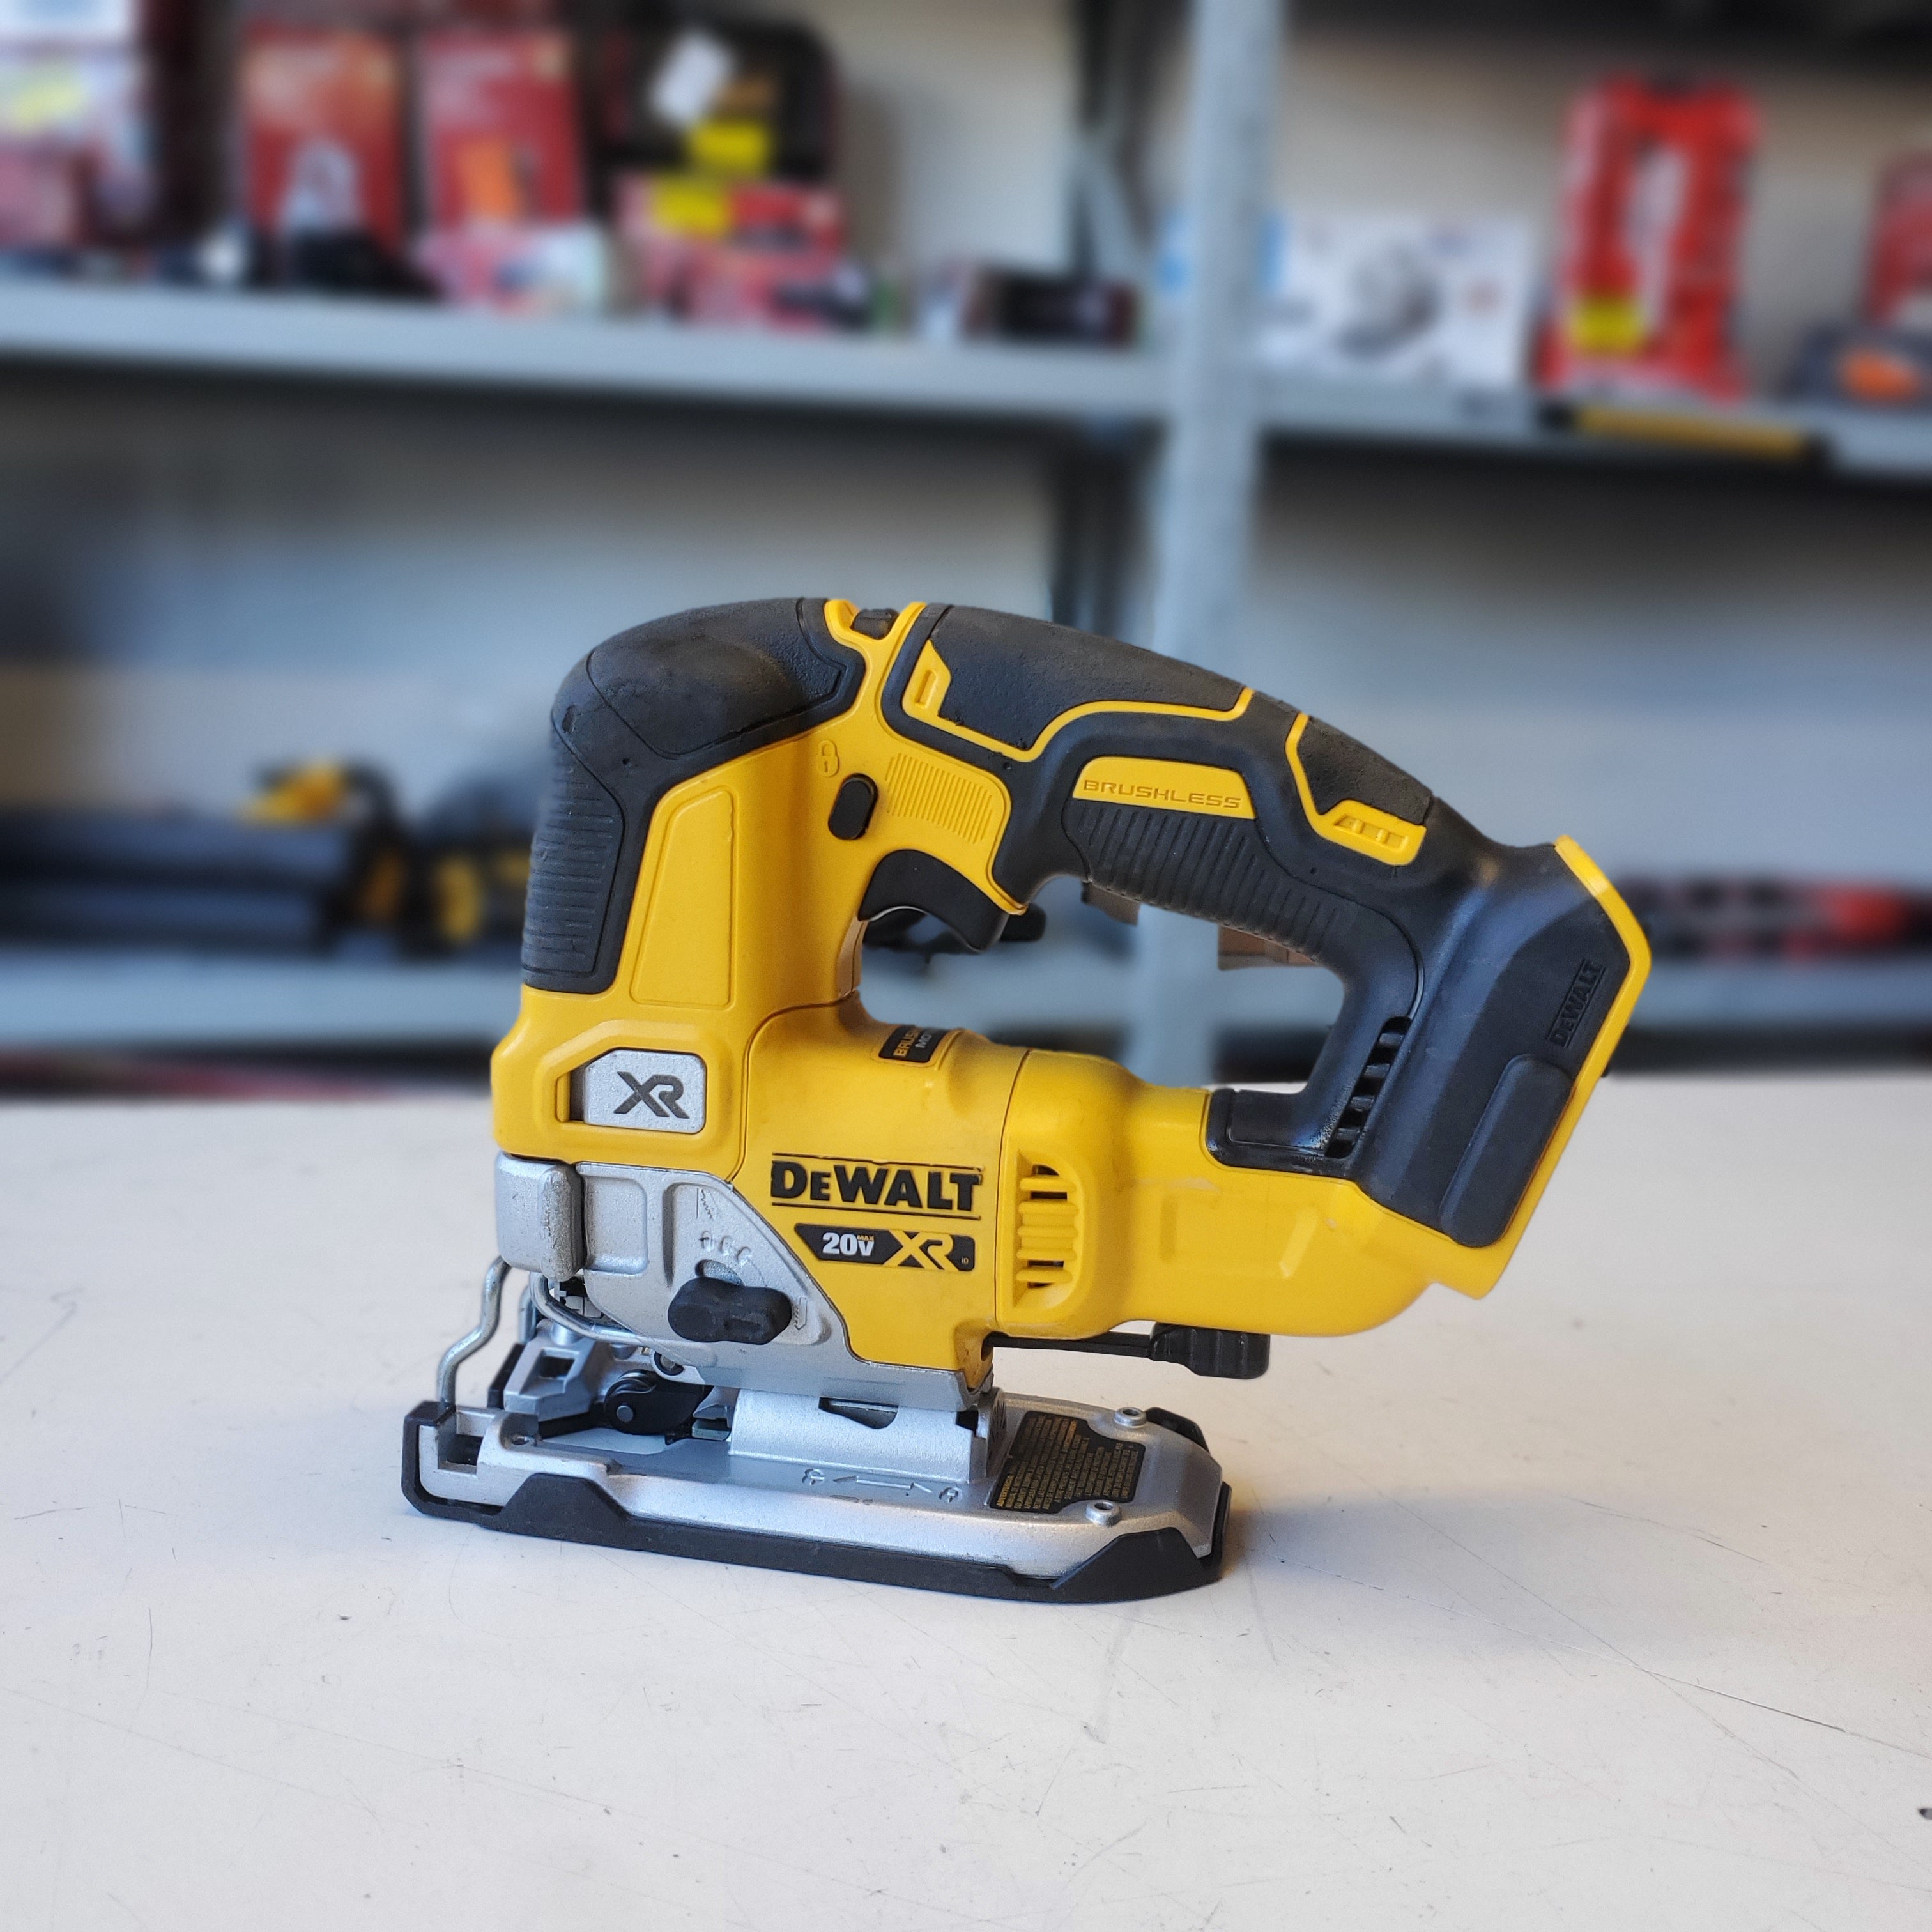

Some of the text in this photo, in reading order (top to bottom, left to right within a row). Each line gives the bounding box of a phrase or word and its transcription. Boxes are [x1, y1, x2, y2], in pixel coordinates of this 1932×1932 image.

[1083, 779, 1241, 809] BRUSHLESS
[613, 1071, 691, 1119] XR
[882, 1229, 960, 1271] XR
